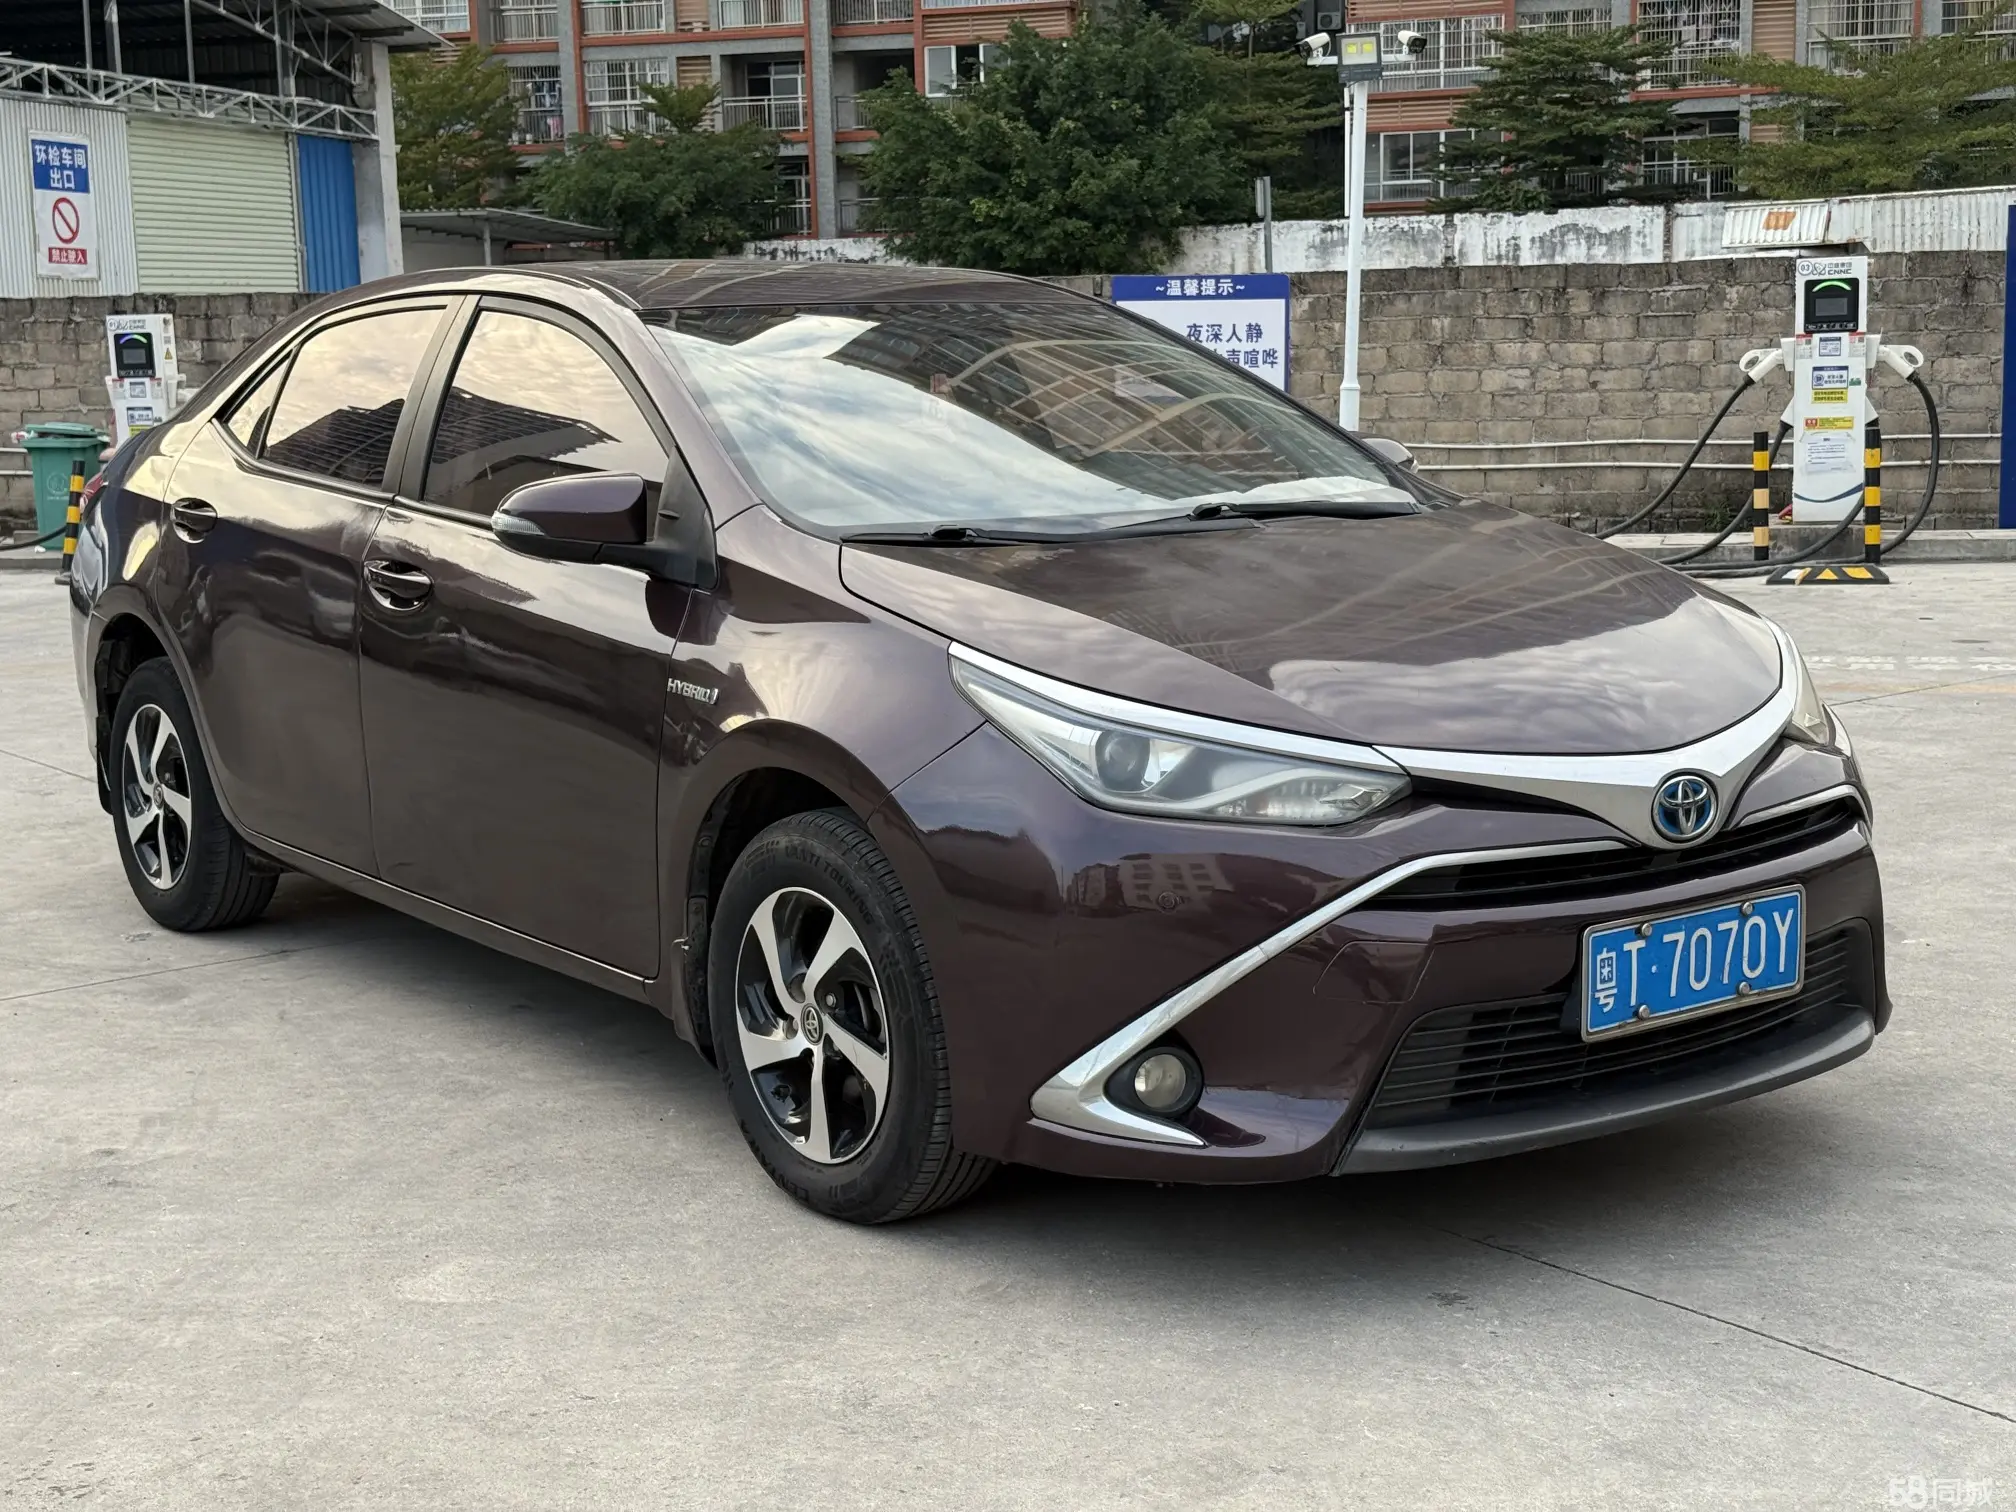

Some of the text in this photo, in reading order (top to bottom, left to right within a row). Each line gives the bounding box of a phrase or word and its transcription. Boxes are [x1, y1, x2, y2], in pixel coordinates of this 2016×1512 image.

[34, 144, 87, 169] 环检车间
[50, 168, 76, 190] 出口
[51, 248, 85, 264] 禁止驶入
[1186, 322, 1264, 344] 夜深人静
[1212, 347, 1279, 369] 声喧哗
[666, 677, 711, 703] HYBRID
